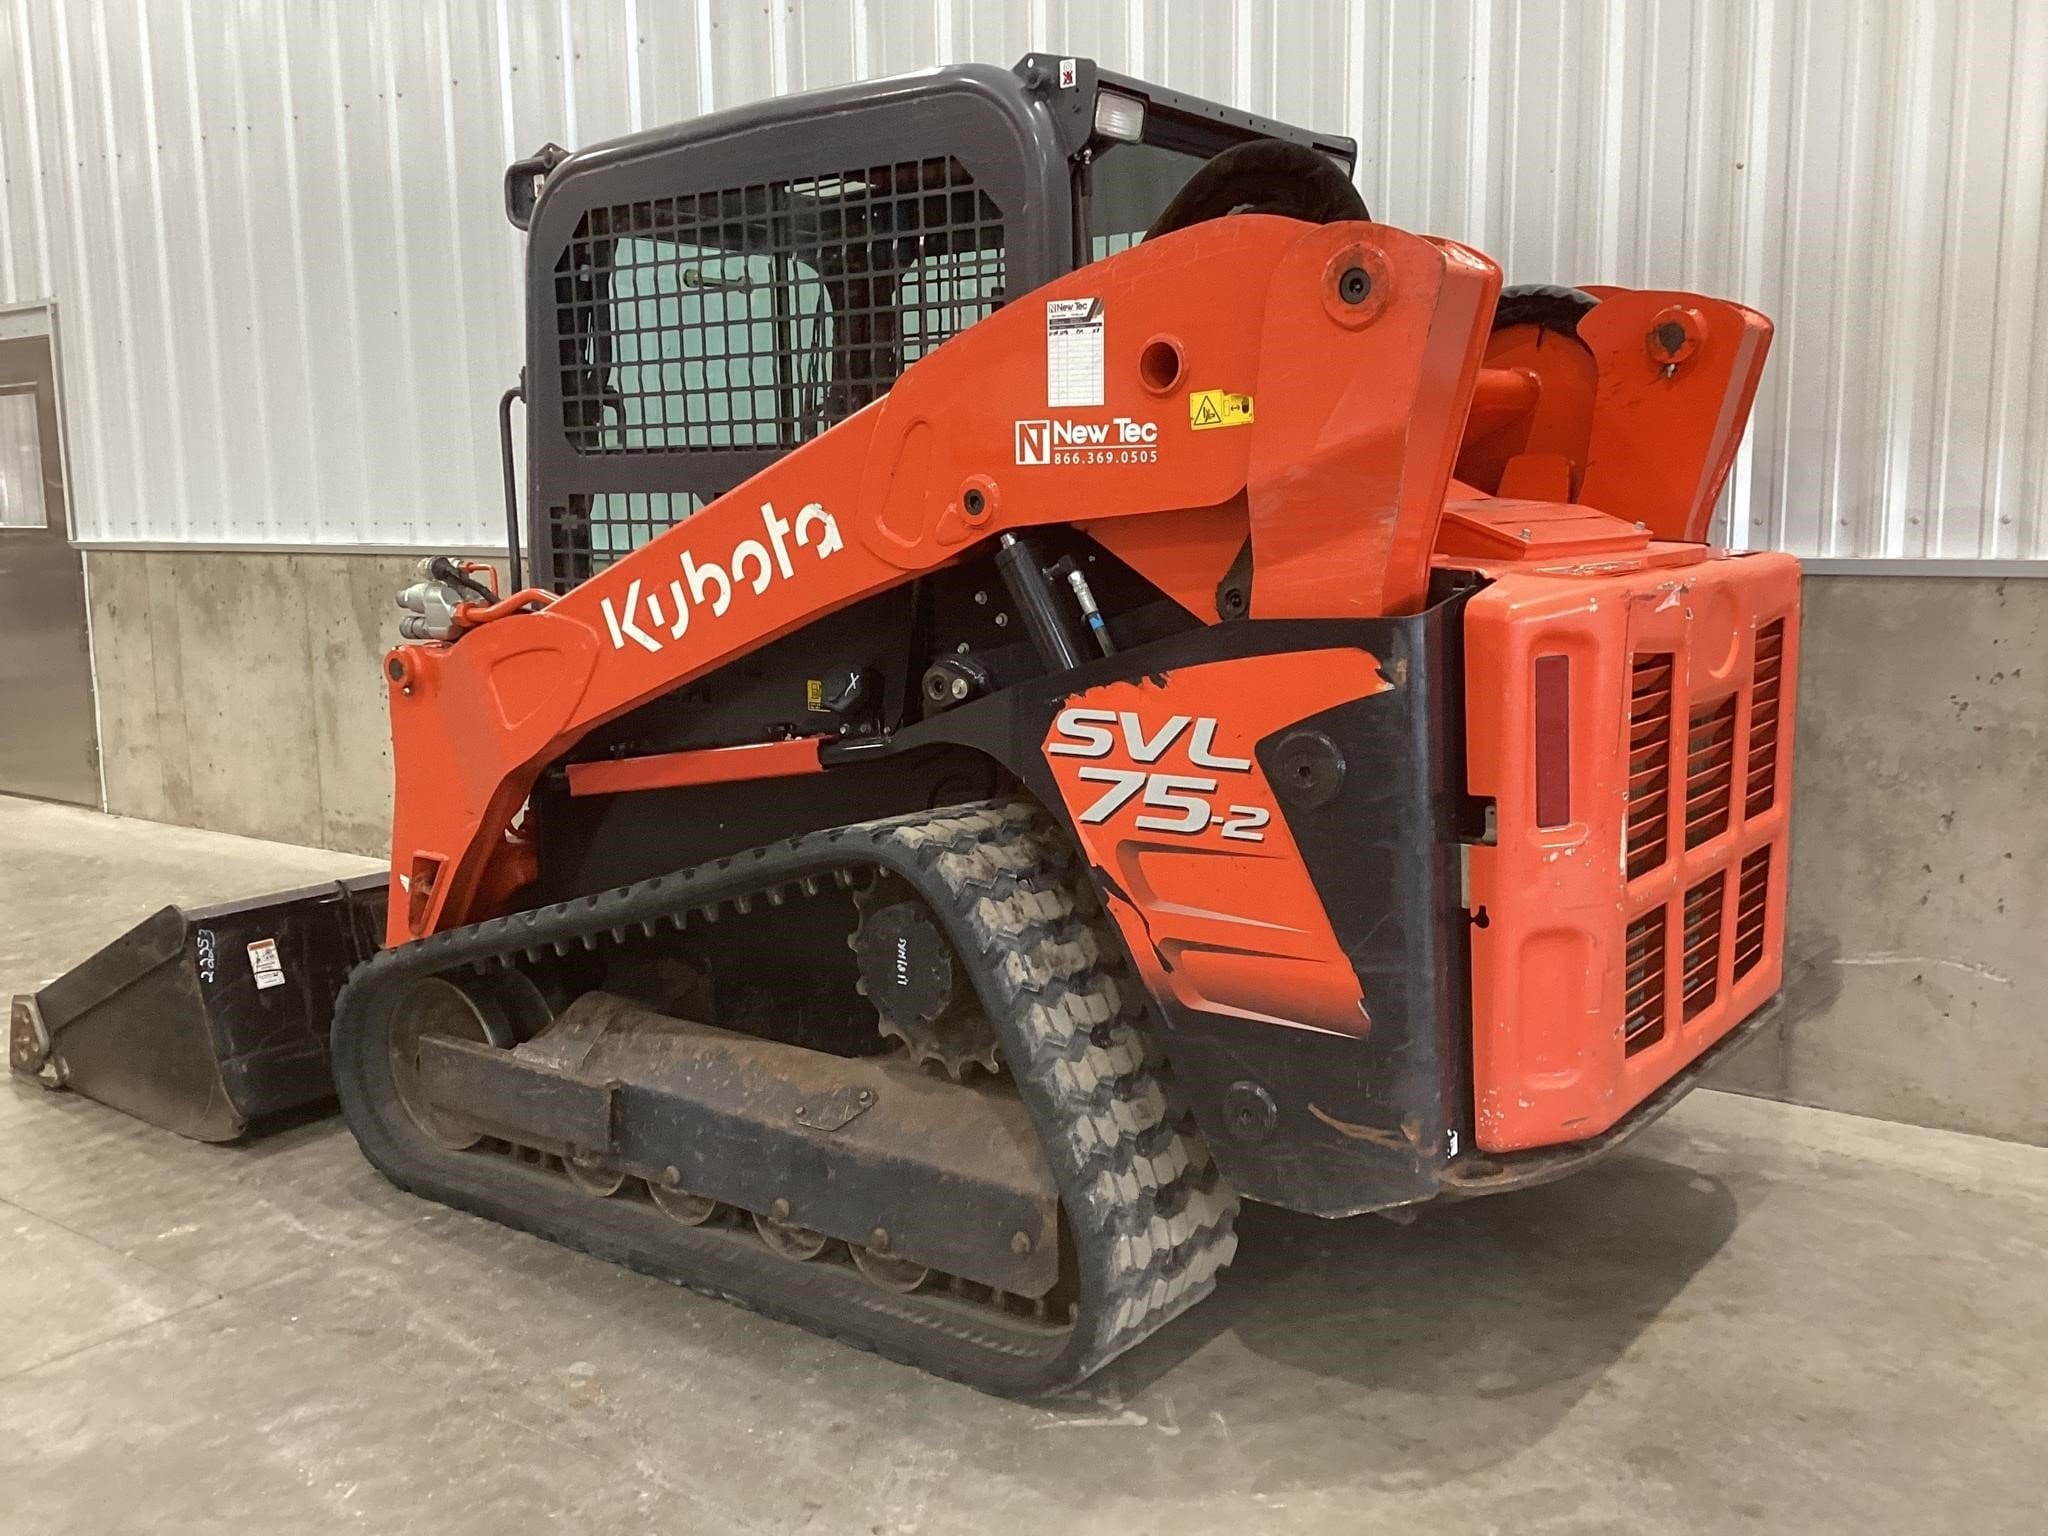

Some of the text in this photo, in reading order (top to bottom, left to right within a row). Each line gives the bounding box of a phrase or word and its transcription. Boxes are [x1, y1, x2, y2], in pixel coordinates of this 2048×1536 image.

[1057, 303, 1074, 313] New
[1074, 301, 1088, 311] Tec
[1053, 417, 1158, 445] New Tec
[1054, 450, 1158, 465] 866.369.0505
[600, 501, 844, 653] Kubota
[1048, 708, 1252, 771] SVL
[1077, 766, 1271, 842] 75-2
